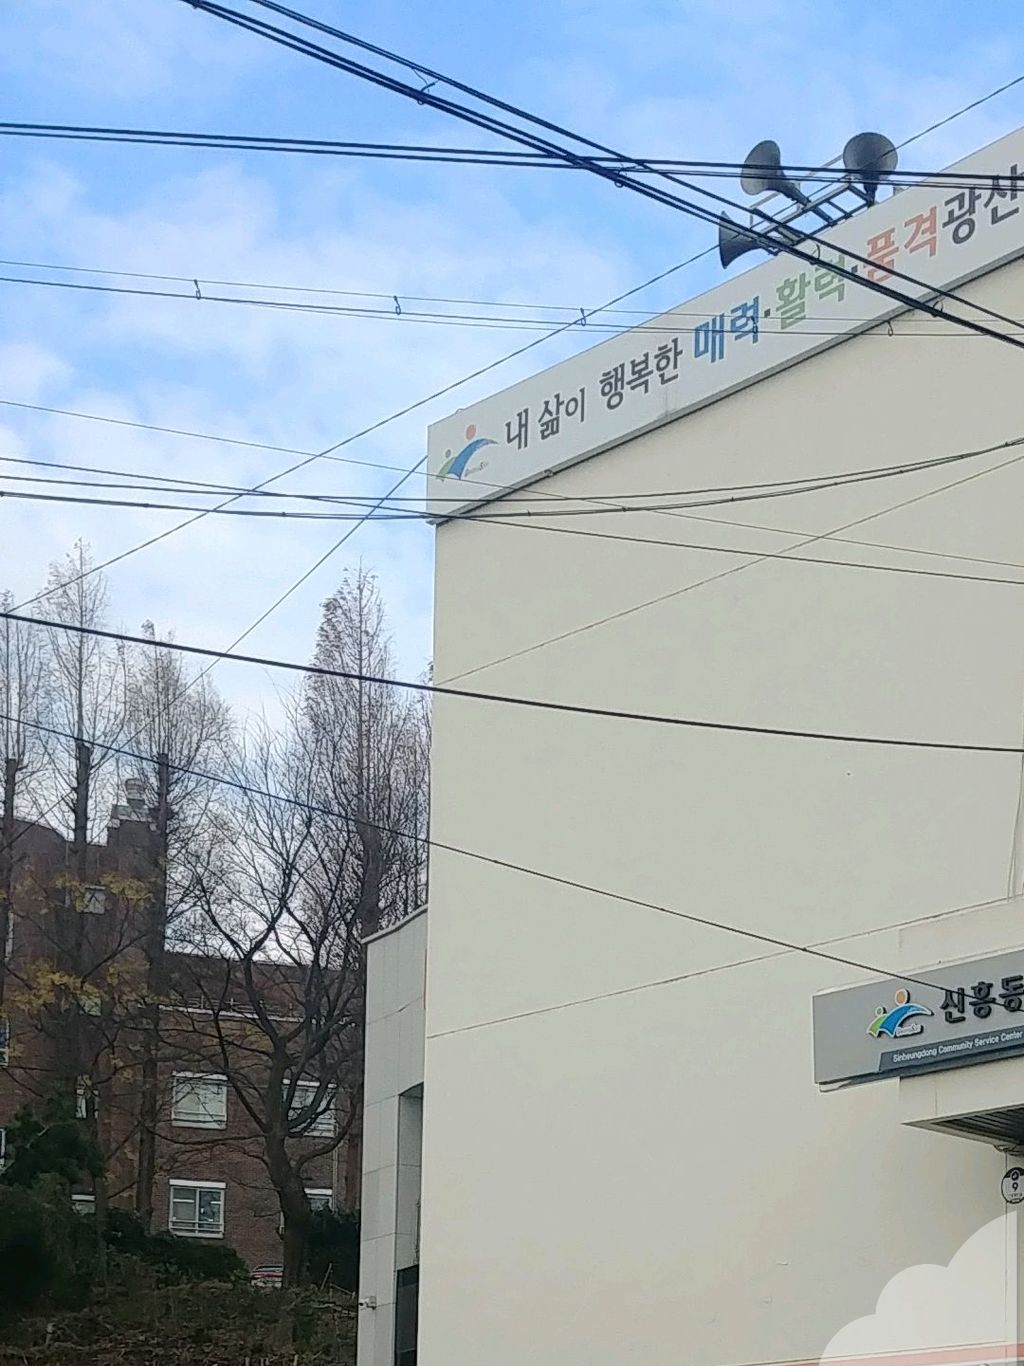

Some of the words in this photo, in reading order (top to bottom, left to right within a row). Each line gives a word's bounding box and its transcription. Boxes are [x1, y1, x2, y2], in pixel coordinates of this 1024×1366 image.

[504, 407, 529, 451] 내
[537, 387, 586, 440] 삶이
[597, 336, 683, 412] 행복한
[938, 1040, 974, 1055] Community
[974, 1034, 1000, 1048] Service
[1000, 1029, 1024, 1042] Center
